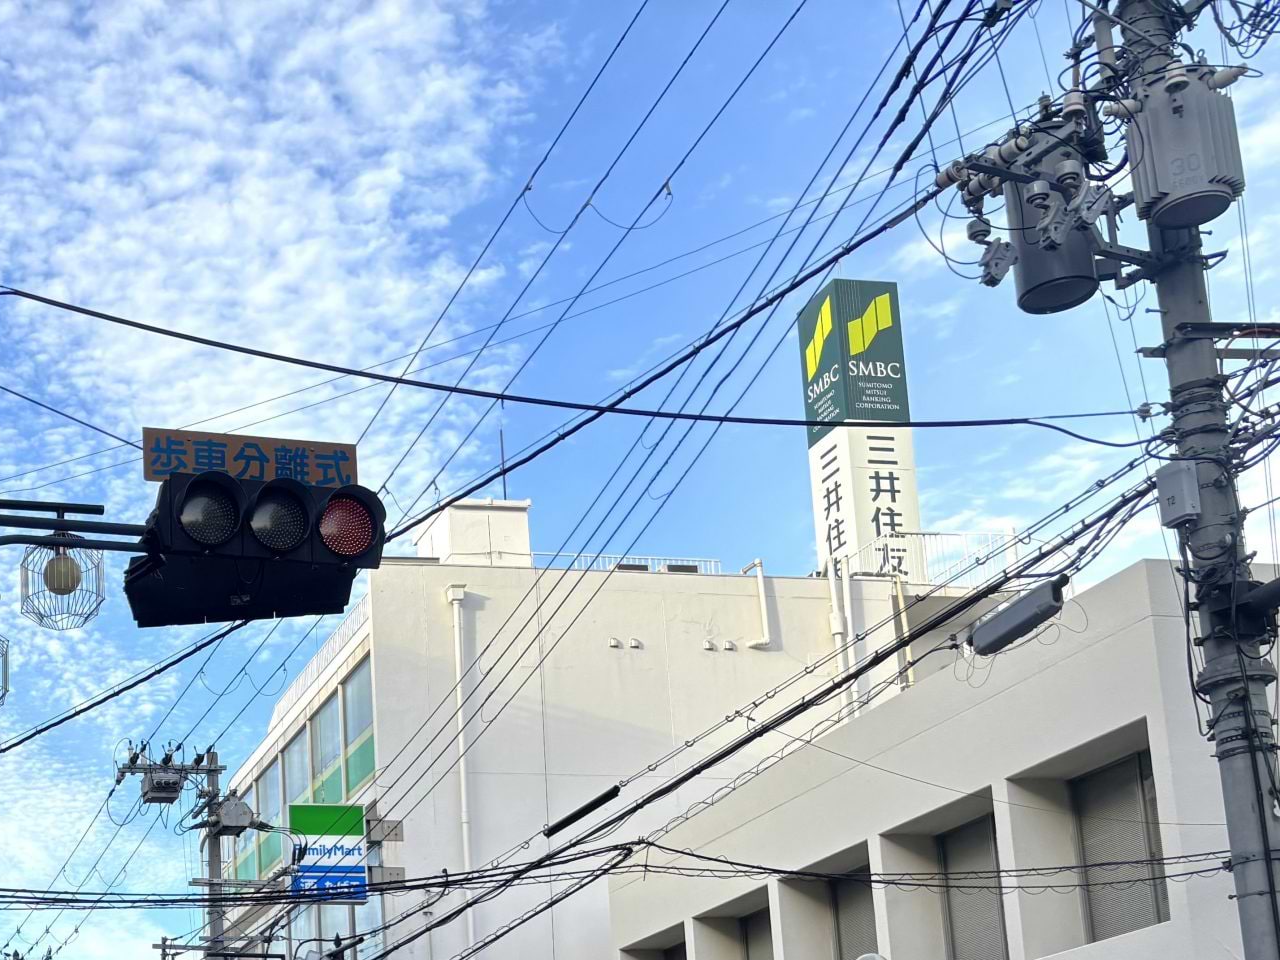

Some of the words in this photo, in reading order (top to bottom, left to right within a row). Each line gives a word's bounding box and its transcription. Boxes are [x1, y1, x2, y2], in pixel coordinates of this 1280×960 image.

[807, 363, 840, 403] SMBC
[847, 360, 901, 379] SMBC
[150, 435, 352, 486] 歩車分離式
[294, 843, 363, 859] FmilyMart
